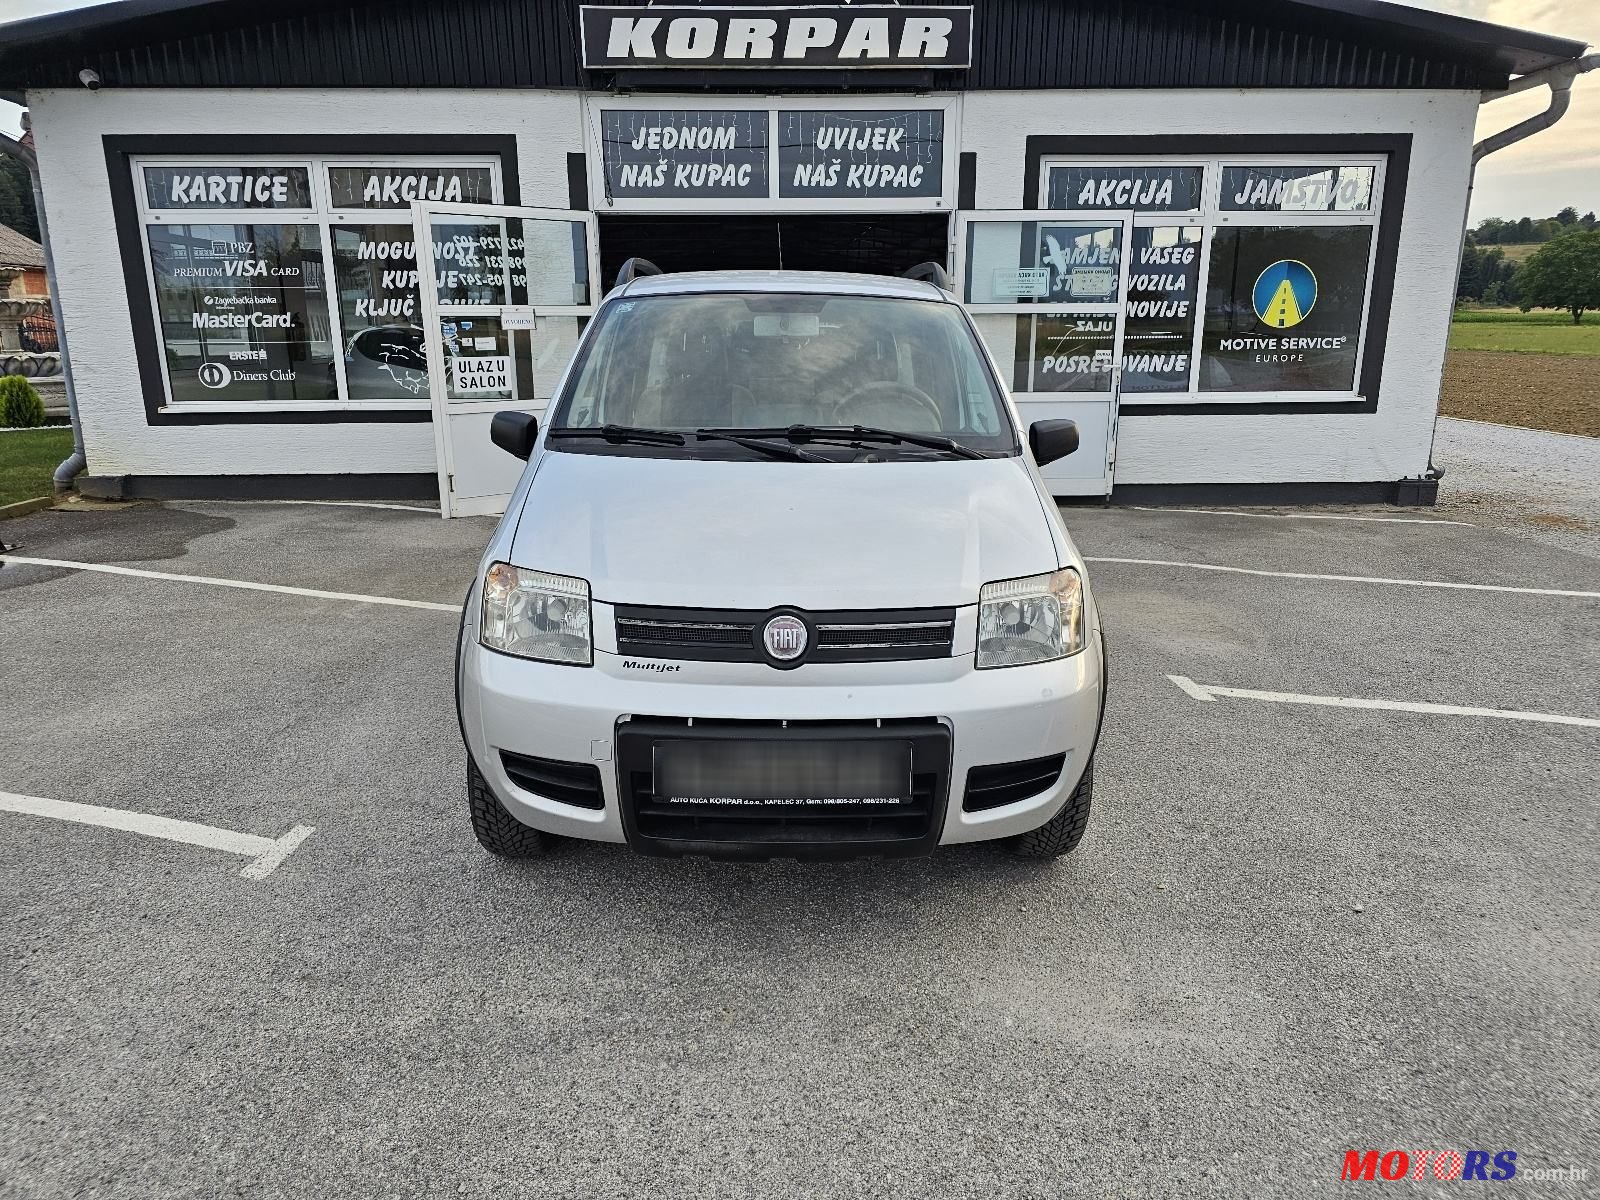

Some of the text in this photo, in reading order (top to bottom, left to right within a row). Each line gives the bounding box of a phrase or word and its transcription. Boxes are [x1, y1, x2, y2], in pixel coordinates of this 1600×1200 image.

[606, 17, 953, 59] KORPAR
[631, 127, 737, 151] JEDNOM
[816, 127, 905, 152] UVIJEK
[620, 159, 752, 189] NAŠ KUPAC
[793, 159, 925, 189] NAŠ KUPAC
[171, 175, 289, 205] KARTICE
[363, 175, 463, 204] AKCIJA
[1077, 179, 1174, 206] AKCIJA
[1234, 179, 1360, 205] JAMSTVO
[230, 242, 255, 254] PBZ
[174, 259, 300, 277] PREMIUM VISA CARD
[1128, 274, 1186, 291] VOZILA
[254, 295, 277, 304] banka
[355, 293, 415, 318] KLJUČ
[1126, 301, 1190, 318] NOVIJE
[1220, 338, 1277, 351] MOTIVE
[229, 350, 259, 361] ERSTE
[1255, 353, 1304, 363] EUROPE
[458, 359, 505, 373] ULAZ U
[232, 369, 268, 381] Diners
[460, 375, 506, 389] SALON
[773, 628, 799, 650] FIAT
[622, 660, 681, 673] Multijet
[709, 797, 743, 805] KORPAR
